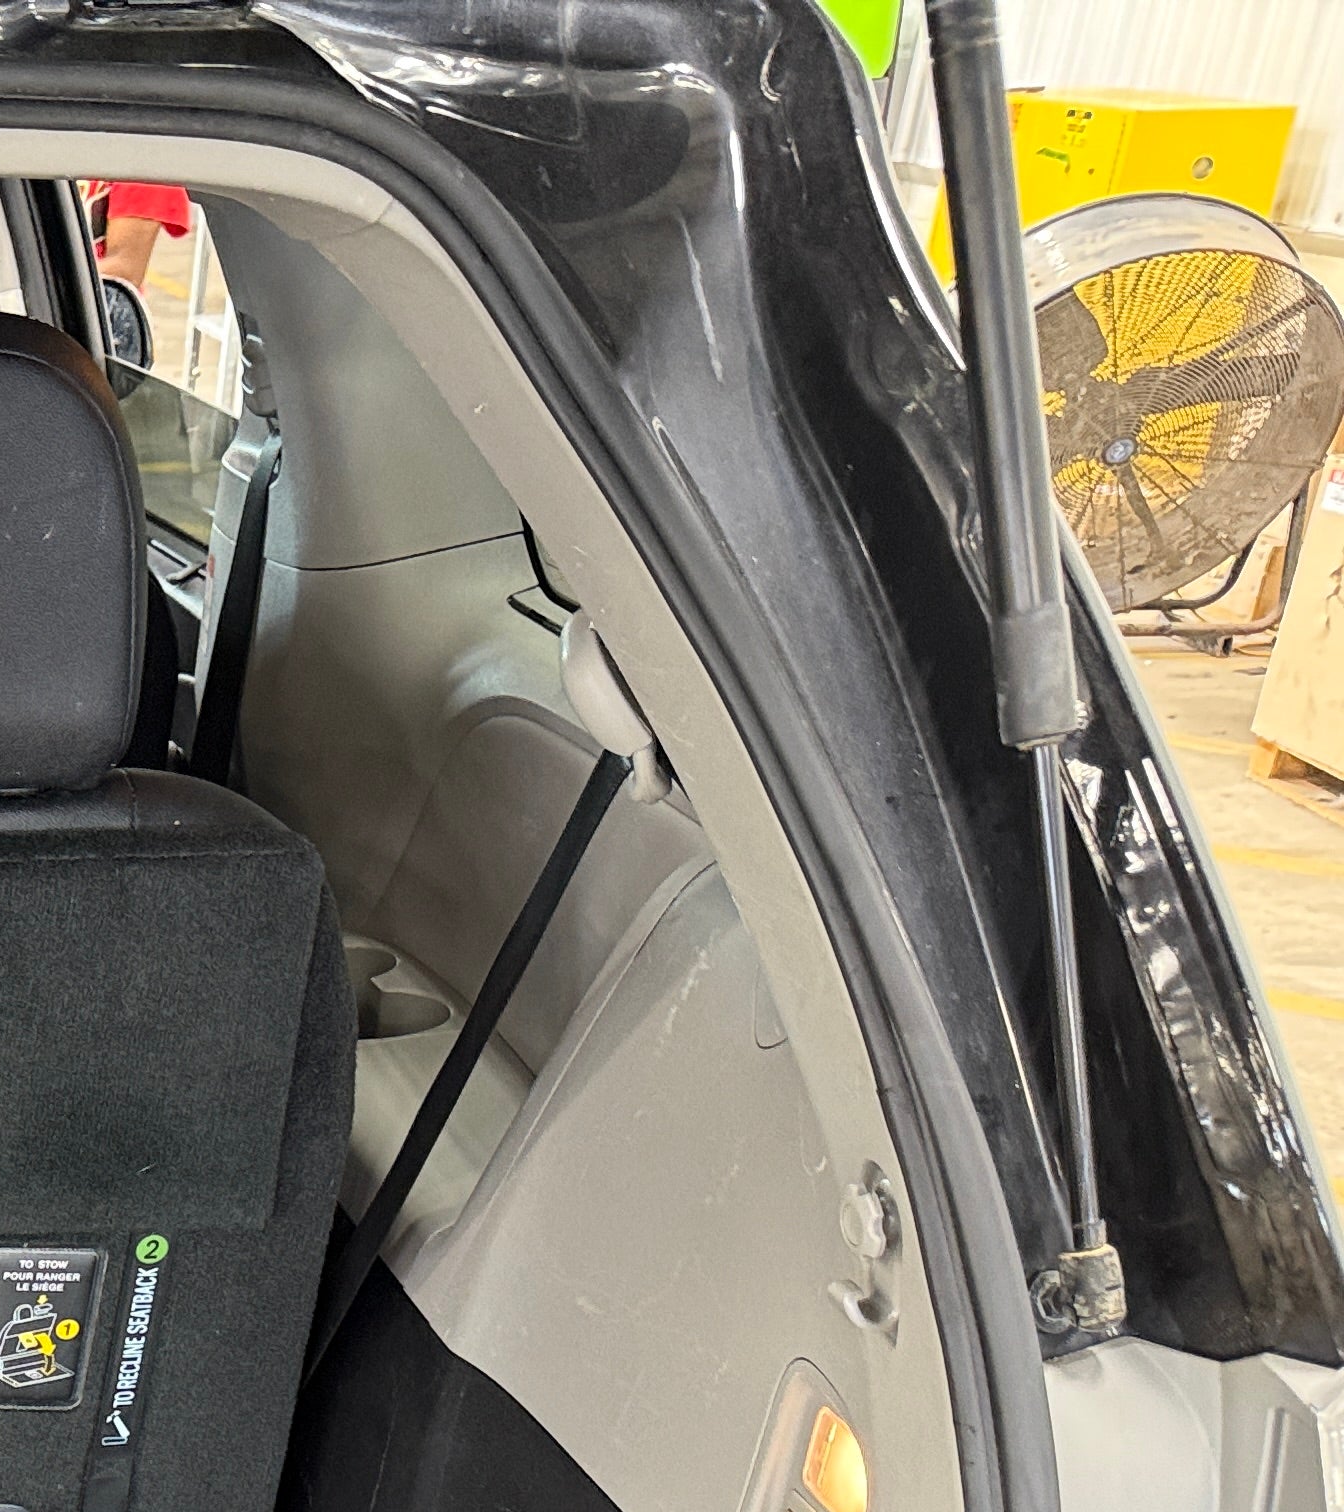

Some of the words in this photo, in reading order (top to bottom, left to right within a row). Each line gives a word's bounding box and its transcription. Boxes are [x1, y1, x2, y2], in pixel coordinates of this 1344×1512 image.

[144, 1239, 160, 1260] 2
[19, 1259, 34, 1269] TO
[38, 1260, 69, 1270] STOW
[3, 1272, 34, 1282] POUR
[36, 1272, 81, 1282] RANGER
[15, 1282, 30, 1291] LE
[126, 1267, 160, 1335] SEATBACK
[116, 1335, 146, 1390] RECLINE
[113, 1390, 136, 1408] TO
